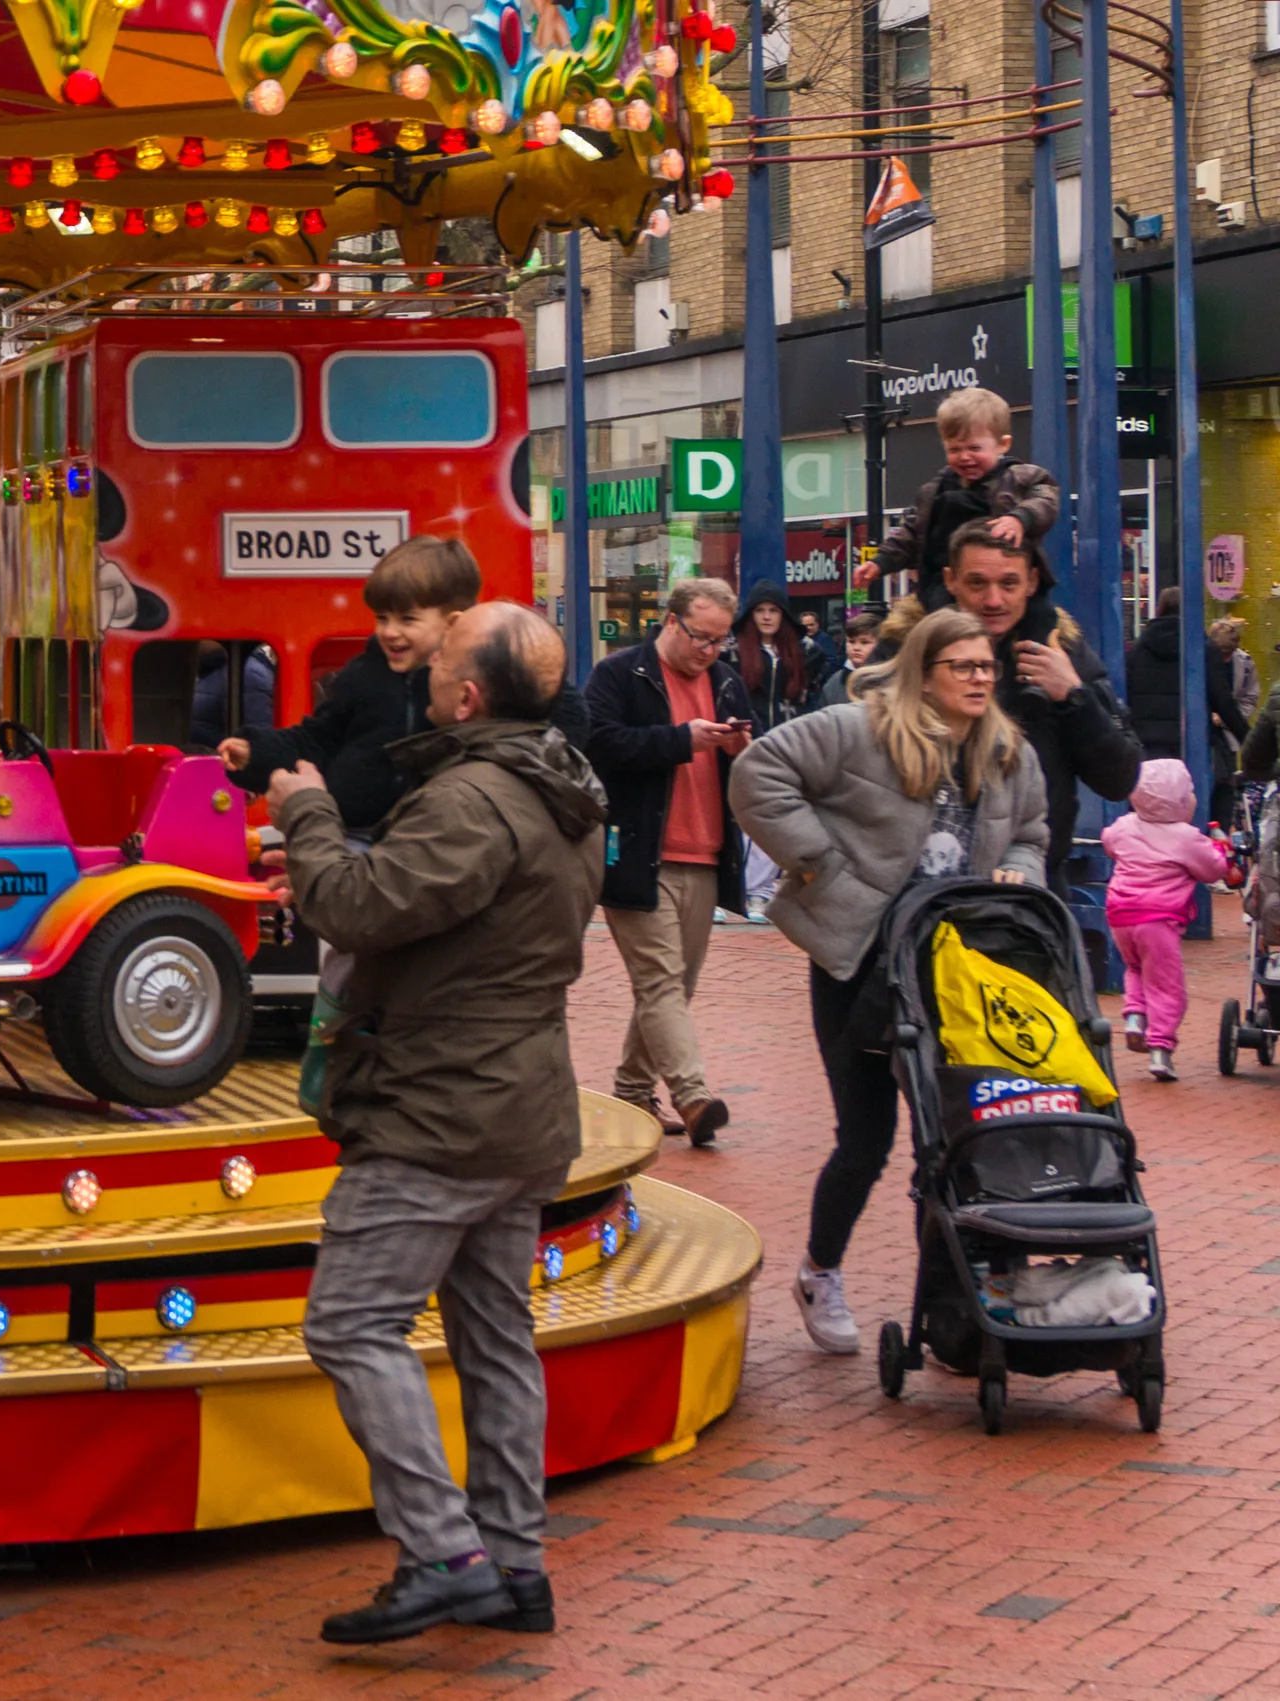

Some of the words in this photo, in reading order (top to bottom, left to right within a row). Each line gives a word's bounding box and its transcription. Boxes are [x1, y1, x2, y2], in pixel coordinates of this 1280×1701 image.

[882, 363, 980, 404] uperdrug
[1116, 416, 1149, 432] ids
[687, 451, 735, 499] D
[551, 476, 657, 521] DHMANN
[237, 530, 331, 559] BROAD
[343, 530, 386, 558] St
[976, 1079, 1077, 1102] SPO
